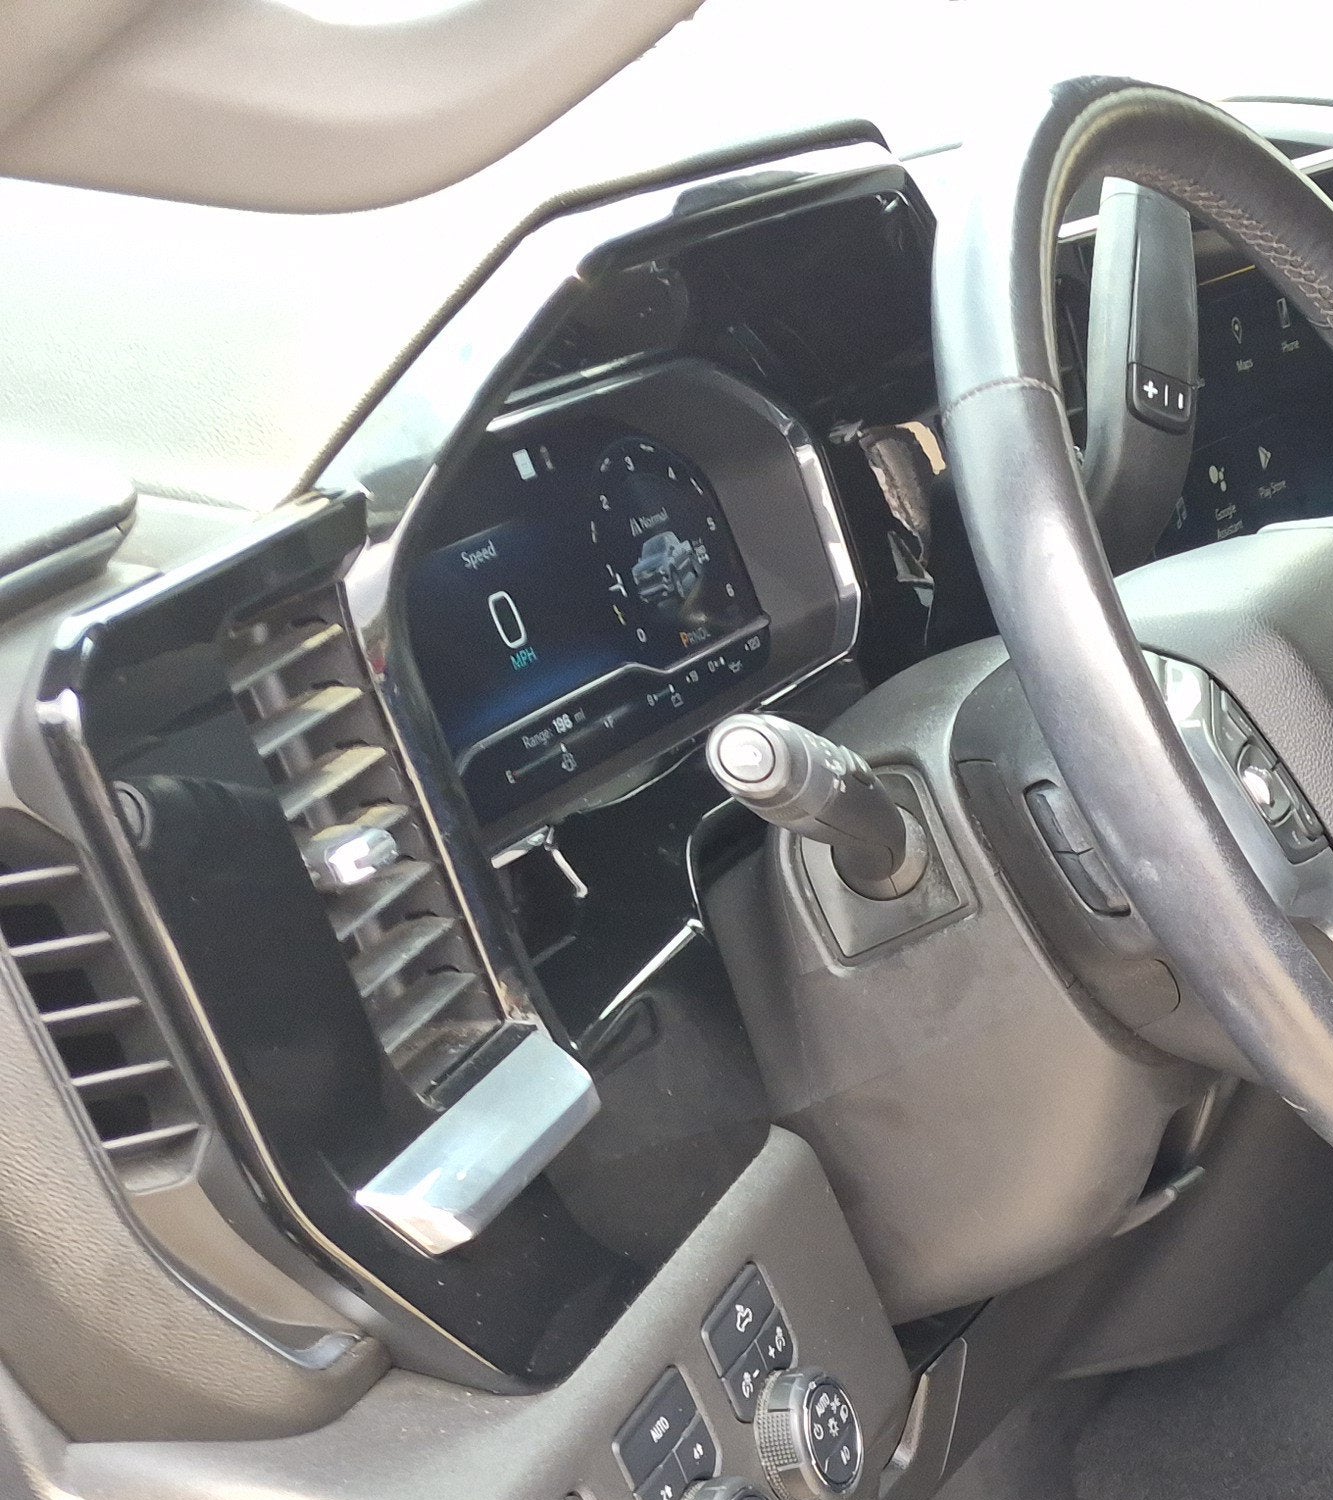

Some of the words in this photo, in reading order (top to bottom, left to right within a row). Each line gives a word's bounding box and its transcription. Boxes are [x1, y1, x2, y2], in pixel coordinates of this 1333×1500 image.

[624, 456, 635, 472] 3
[600, 494, 611, 511] 2
[461, 539, 498, 570] Speed
[488, 590, 527, 649] 0
[636, 627, 648, 643] 0
[510, 646, 539, 672] MPH
[649, 1415, 671, 1444] AUTO
